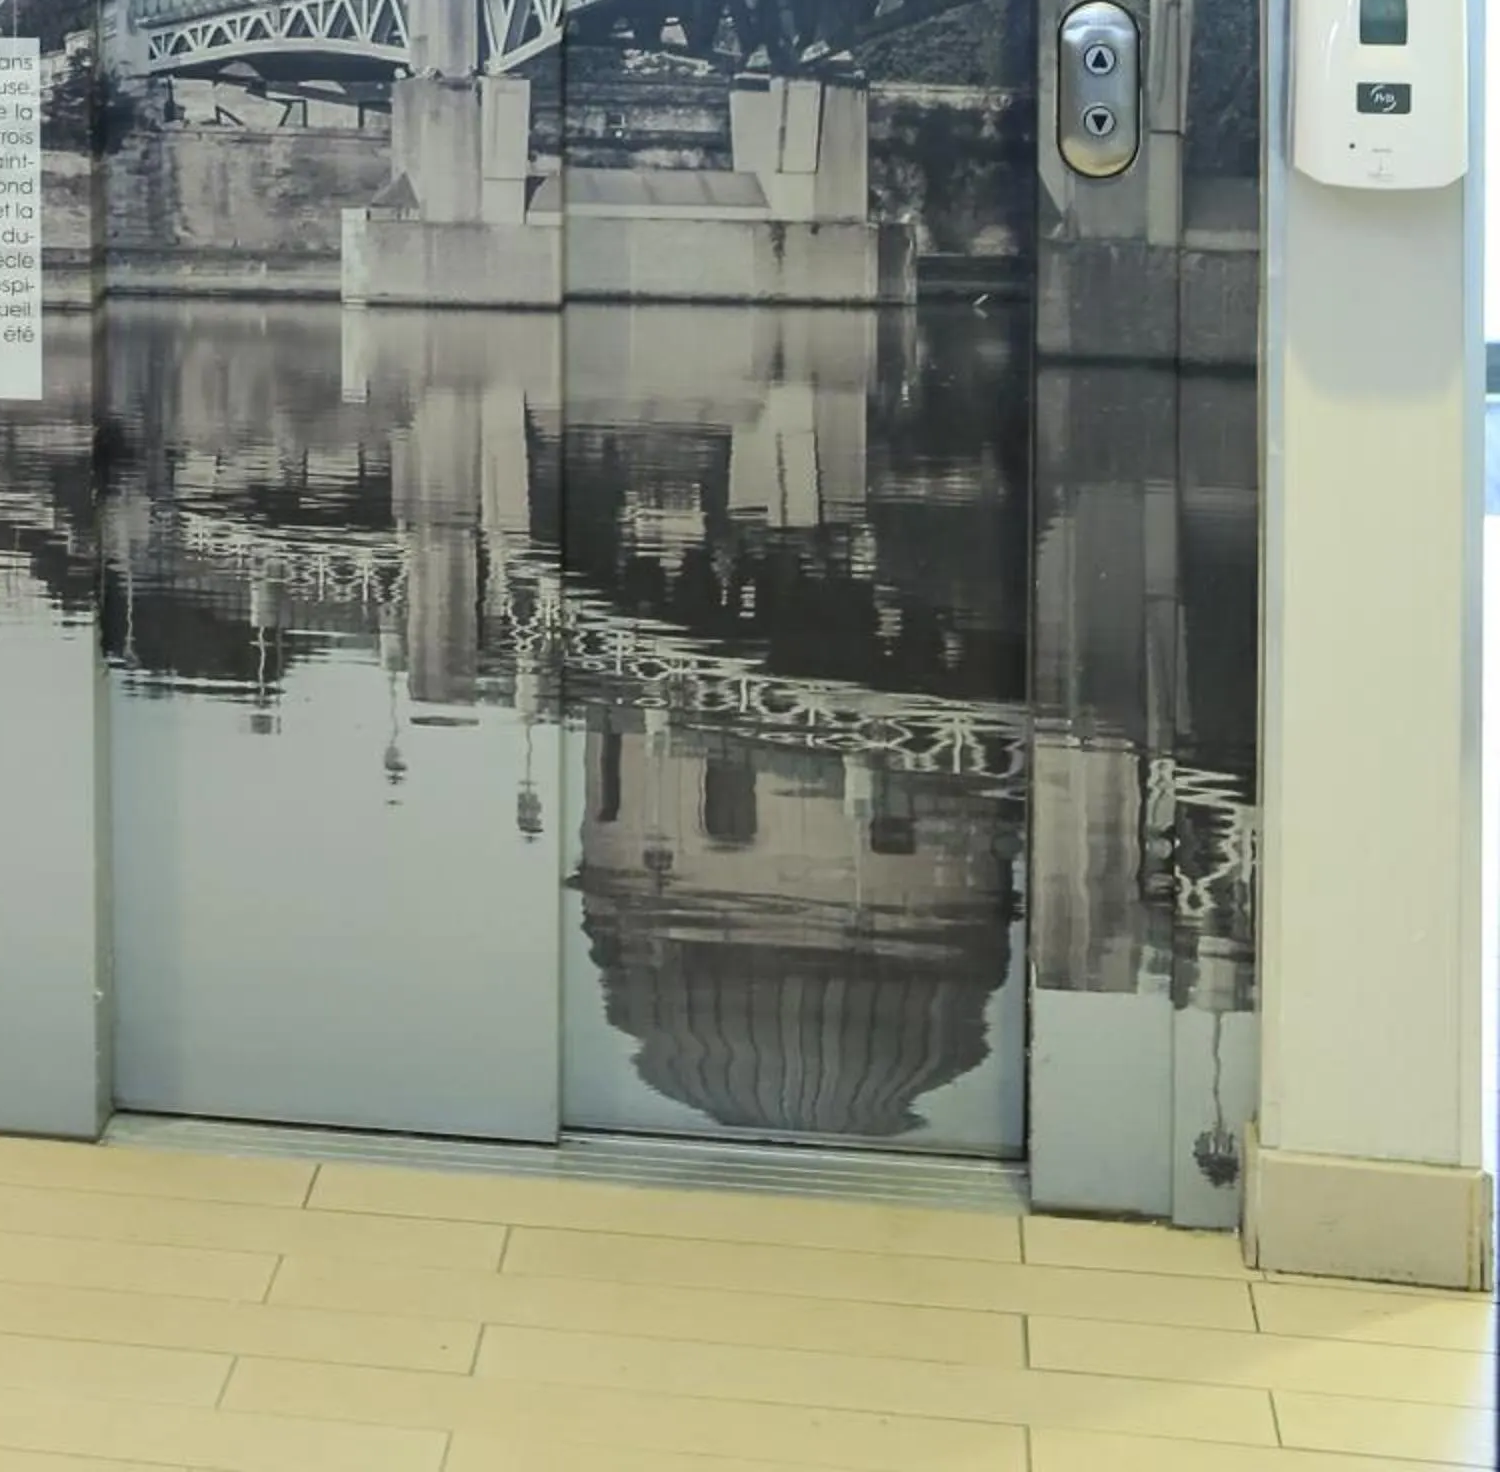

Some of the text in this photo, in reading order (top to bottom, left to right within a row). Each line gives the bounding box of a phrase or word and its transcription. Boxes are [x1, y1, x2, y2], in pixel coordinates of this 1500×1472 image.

[15, 102, 33, 120] la
[16, 201, 33, 219] la
[2, 226, 35, 244] du-
[3, 325, 35, 343] été
